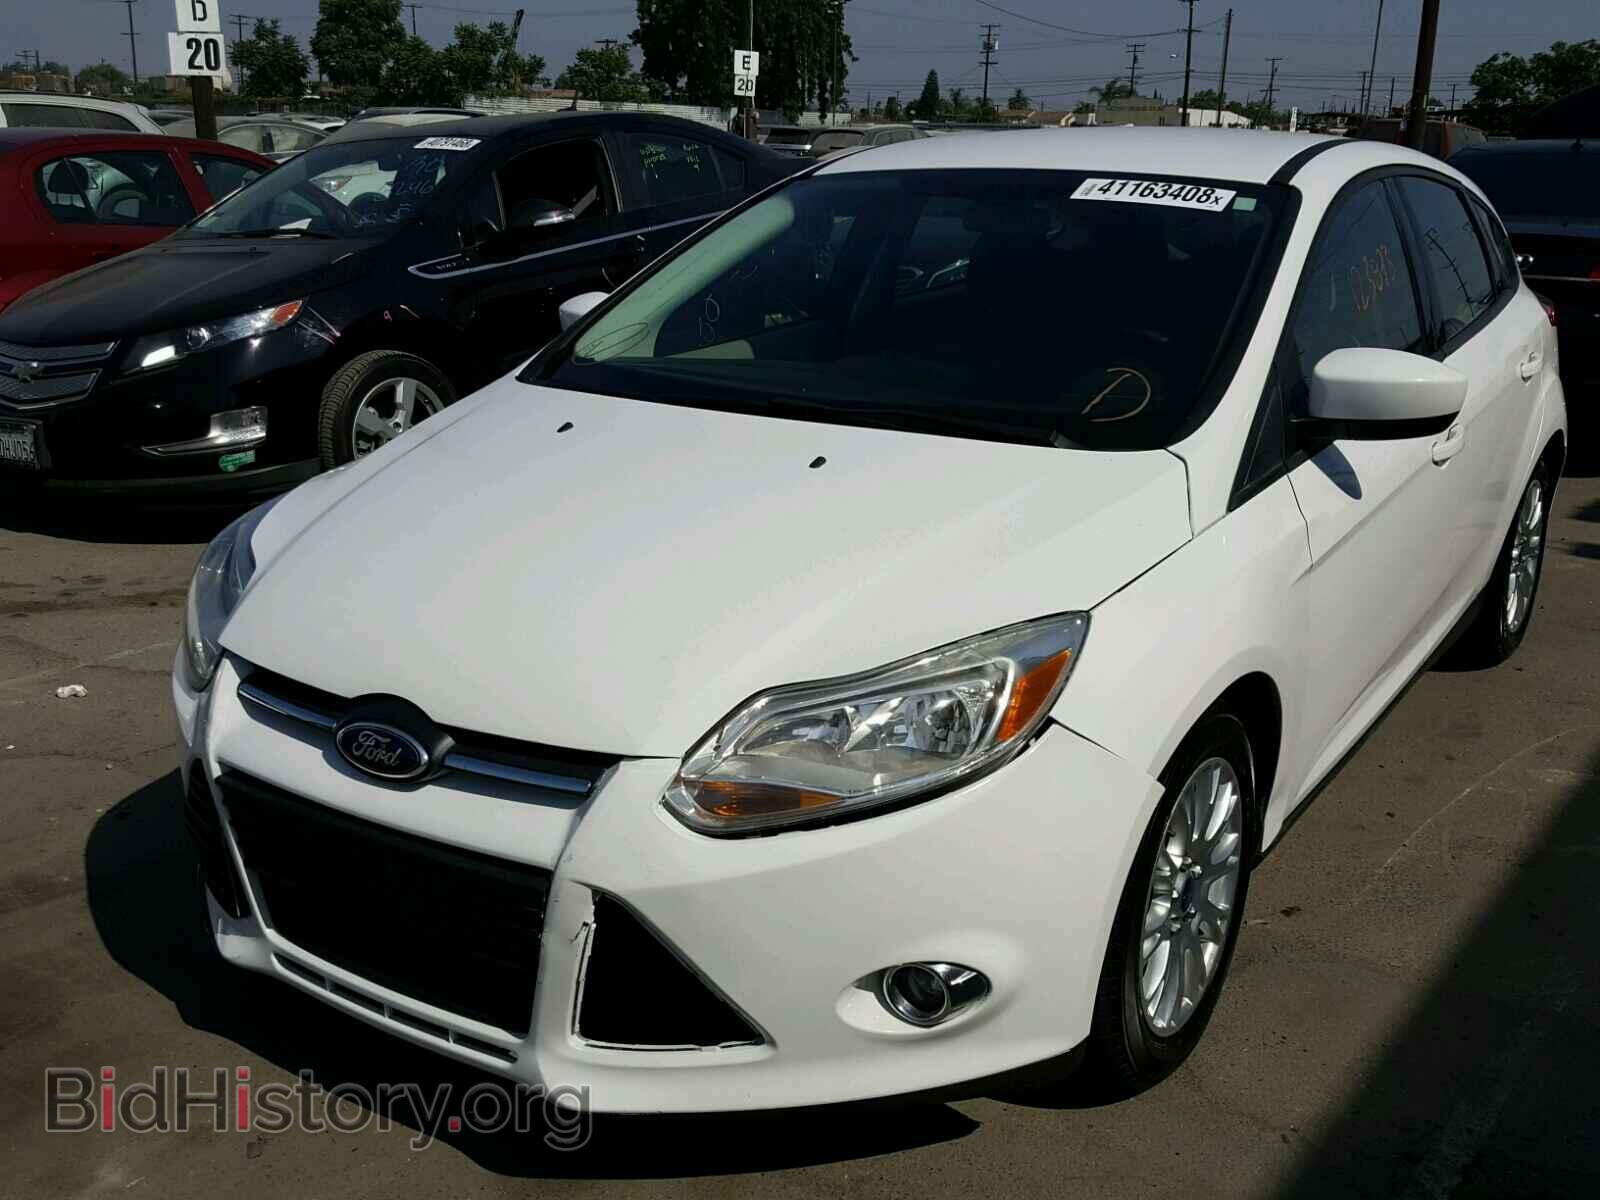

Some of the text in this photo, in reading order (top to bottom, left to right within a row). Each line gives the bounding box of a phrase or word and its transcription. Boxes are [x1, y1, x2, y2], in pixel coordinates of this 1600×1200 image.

[186, 37, 220, 71] 20
[742, 55, 751, 70] E
[737, 78, 754, 91] 20
[353, 730, 402, 766] Ford
